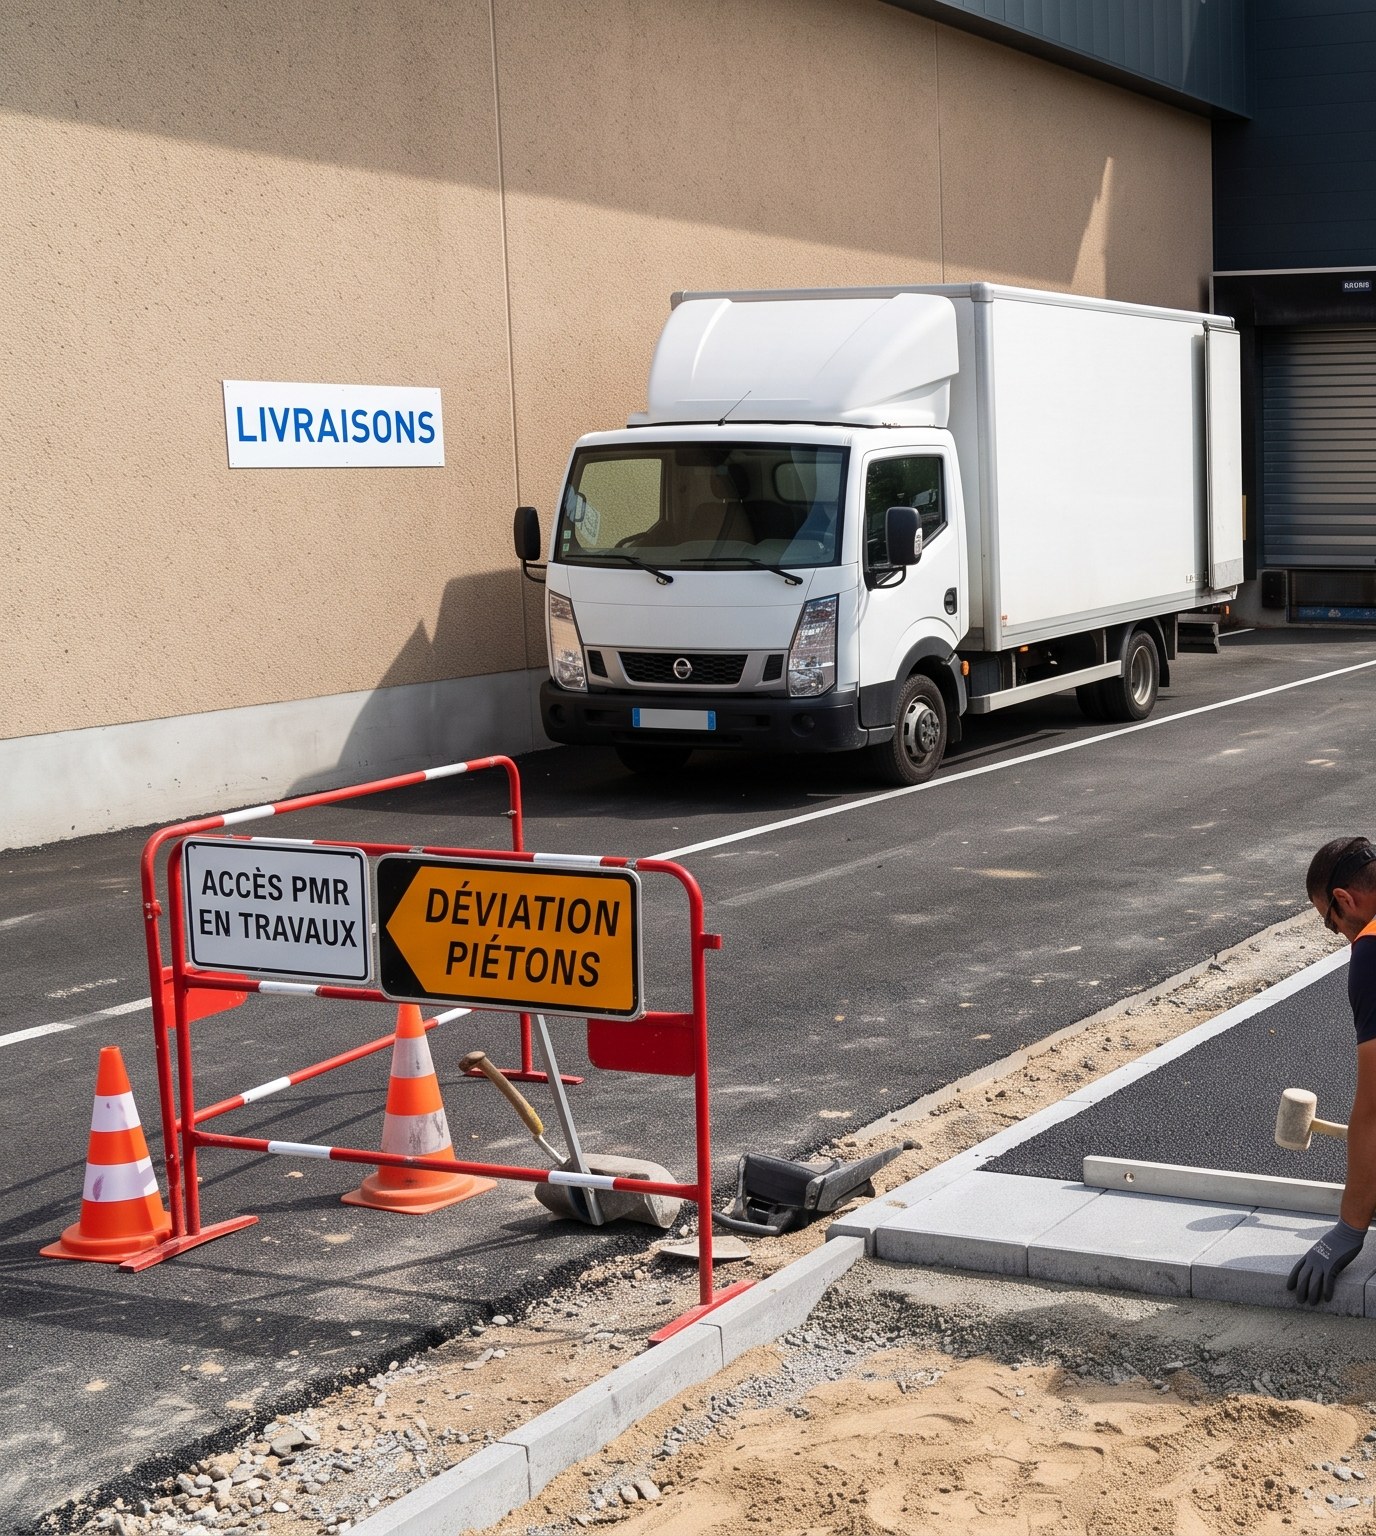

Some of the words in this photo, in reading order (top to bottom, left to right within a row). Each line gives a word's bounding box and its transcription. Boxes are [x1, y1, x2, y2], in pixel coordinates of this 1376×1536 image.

[236, 406, 436, 444] LIVRAISONS
[201, 866, 283, 902] ACCÈS
[291, 875, 351, 906] PMR
[199, 908, 231, 938] EN
[238, 911, 358, 948] TRAVAUX
[425, 880, 621, 937] DÉVIATION
[445, 934, 601, 988] PIÉTONS
